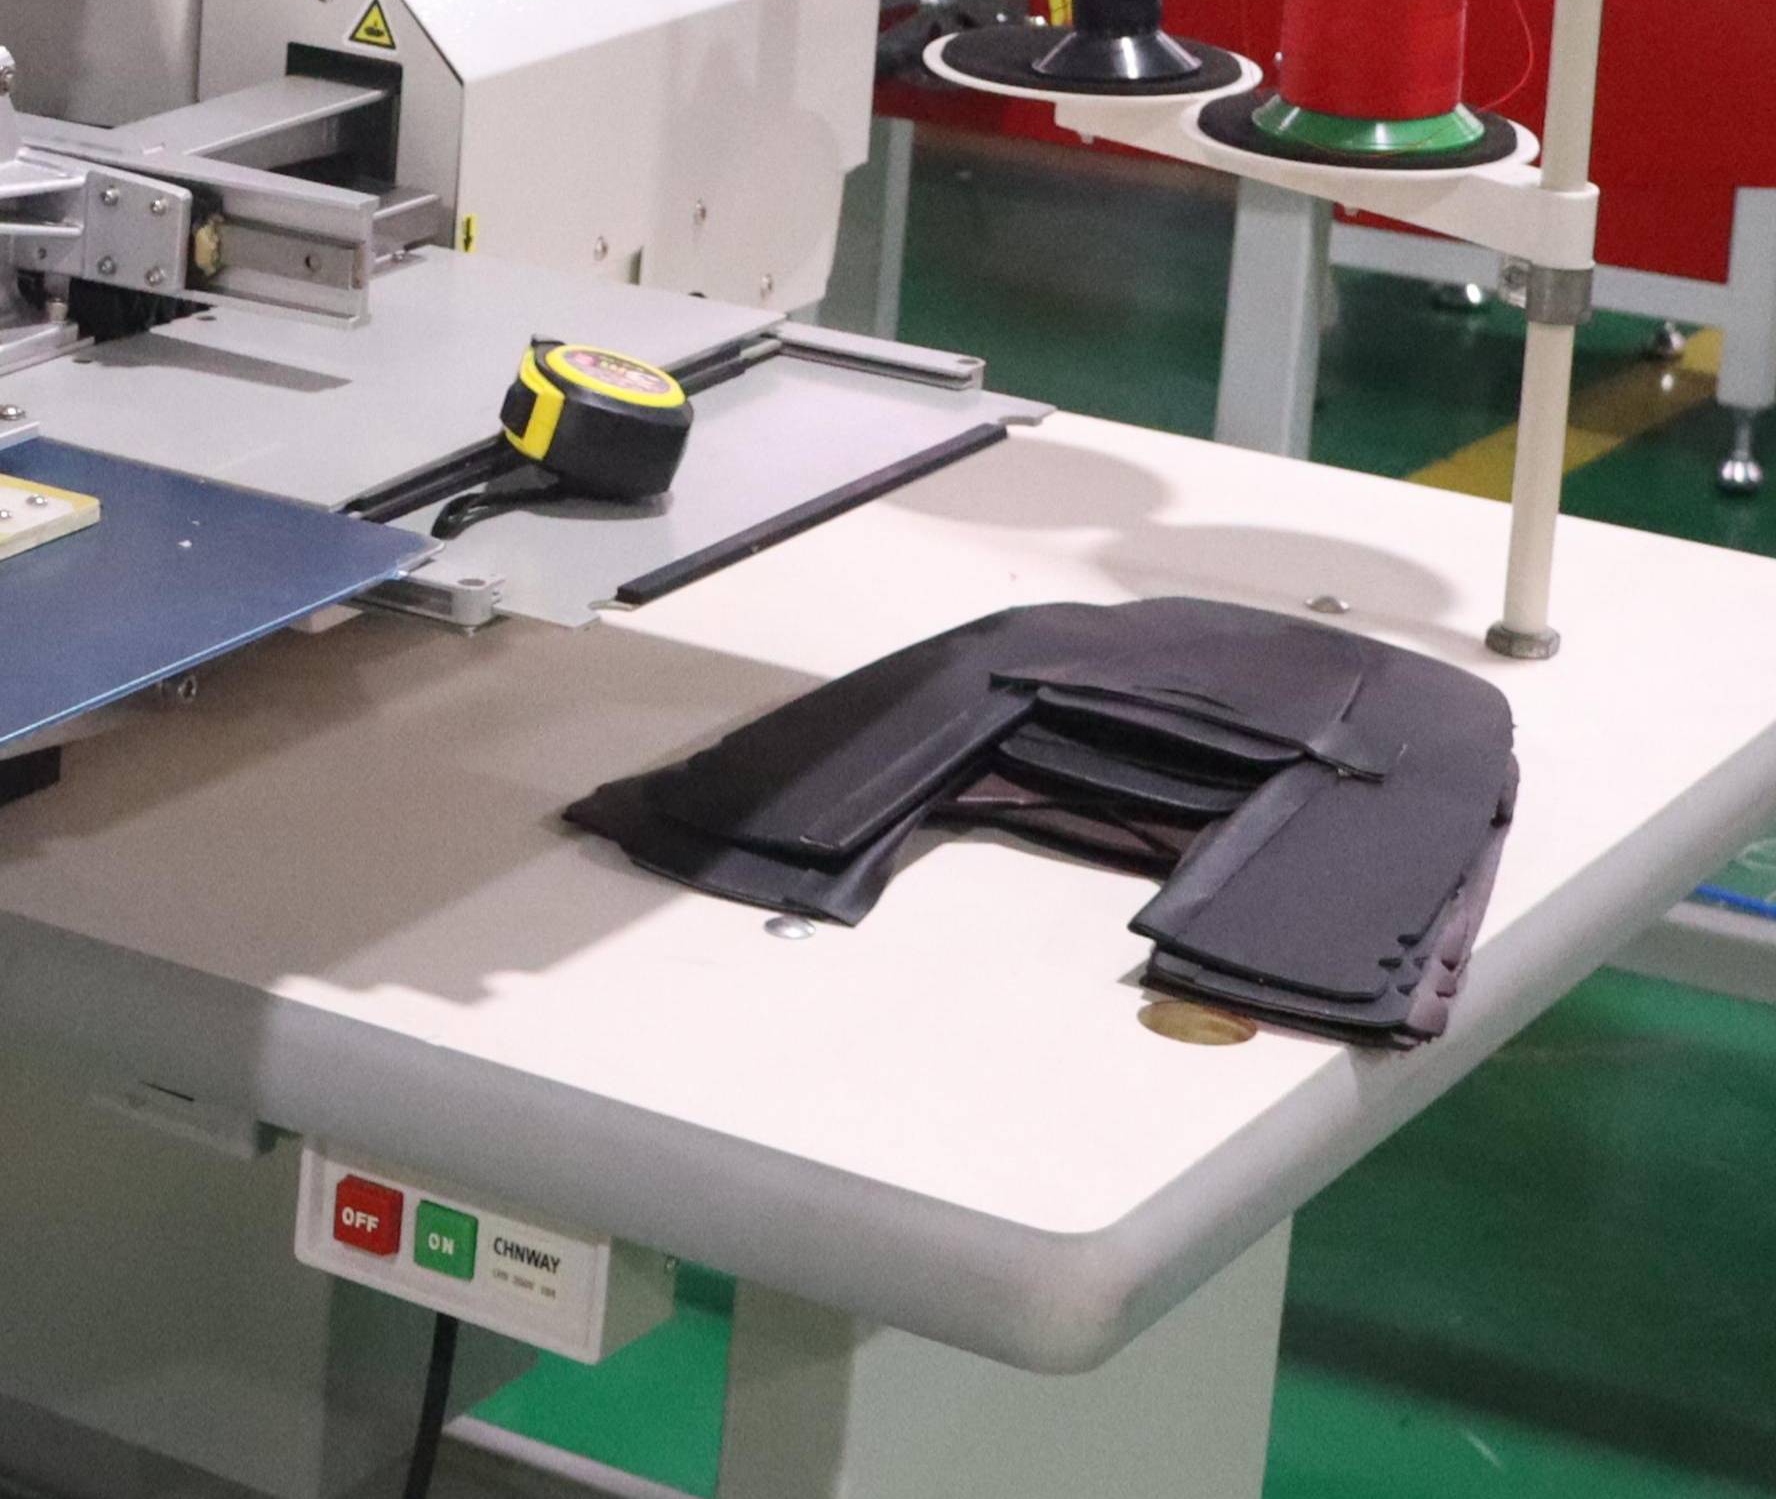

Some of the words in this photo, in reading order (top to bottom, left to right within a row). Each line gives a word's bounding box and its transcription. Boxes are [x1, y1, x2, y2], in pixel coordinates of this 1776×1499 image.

[342, 1206, 379, 1233] OFF
[428, 1232, 454, 1255] ON
[493, 1237, 560, 1275] CHNWAY
